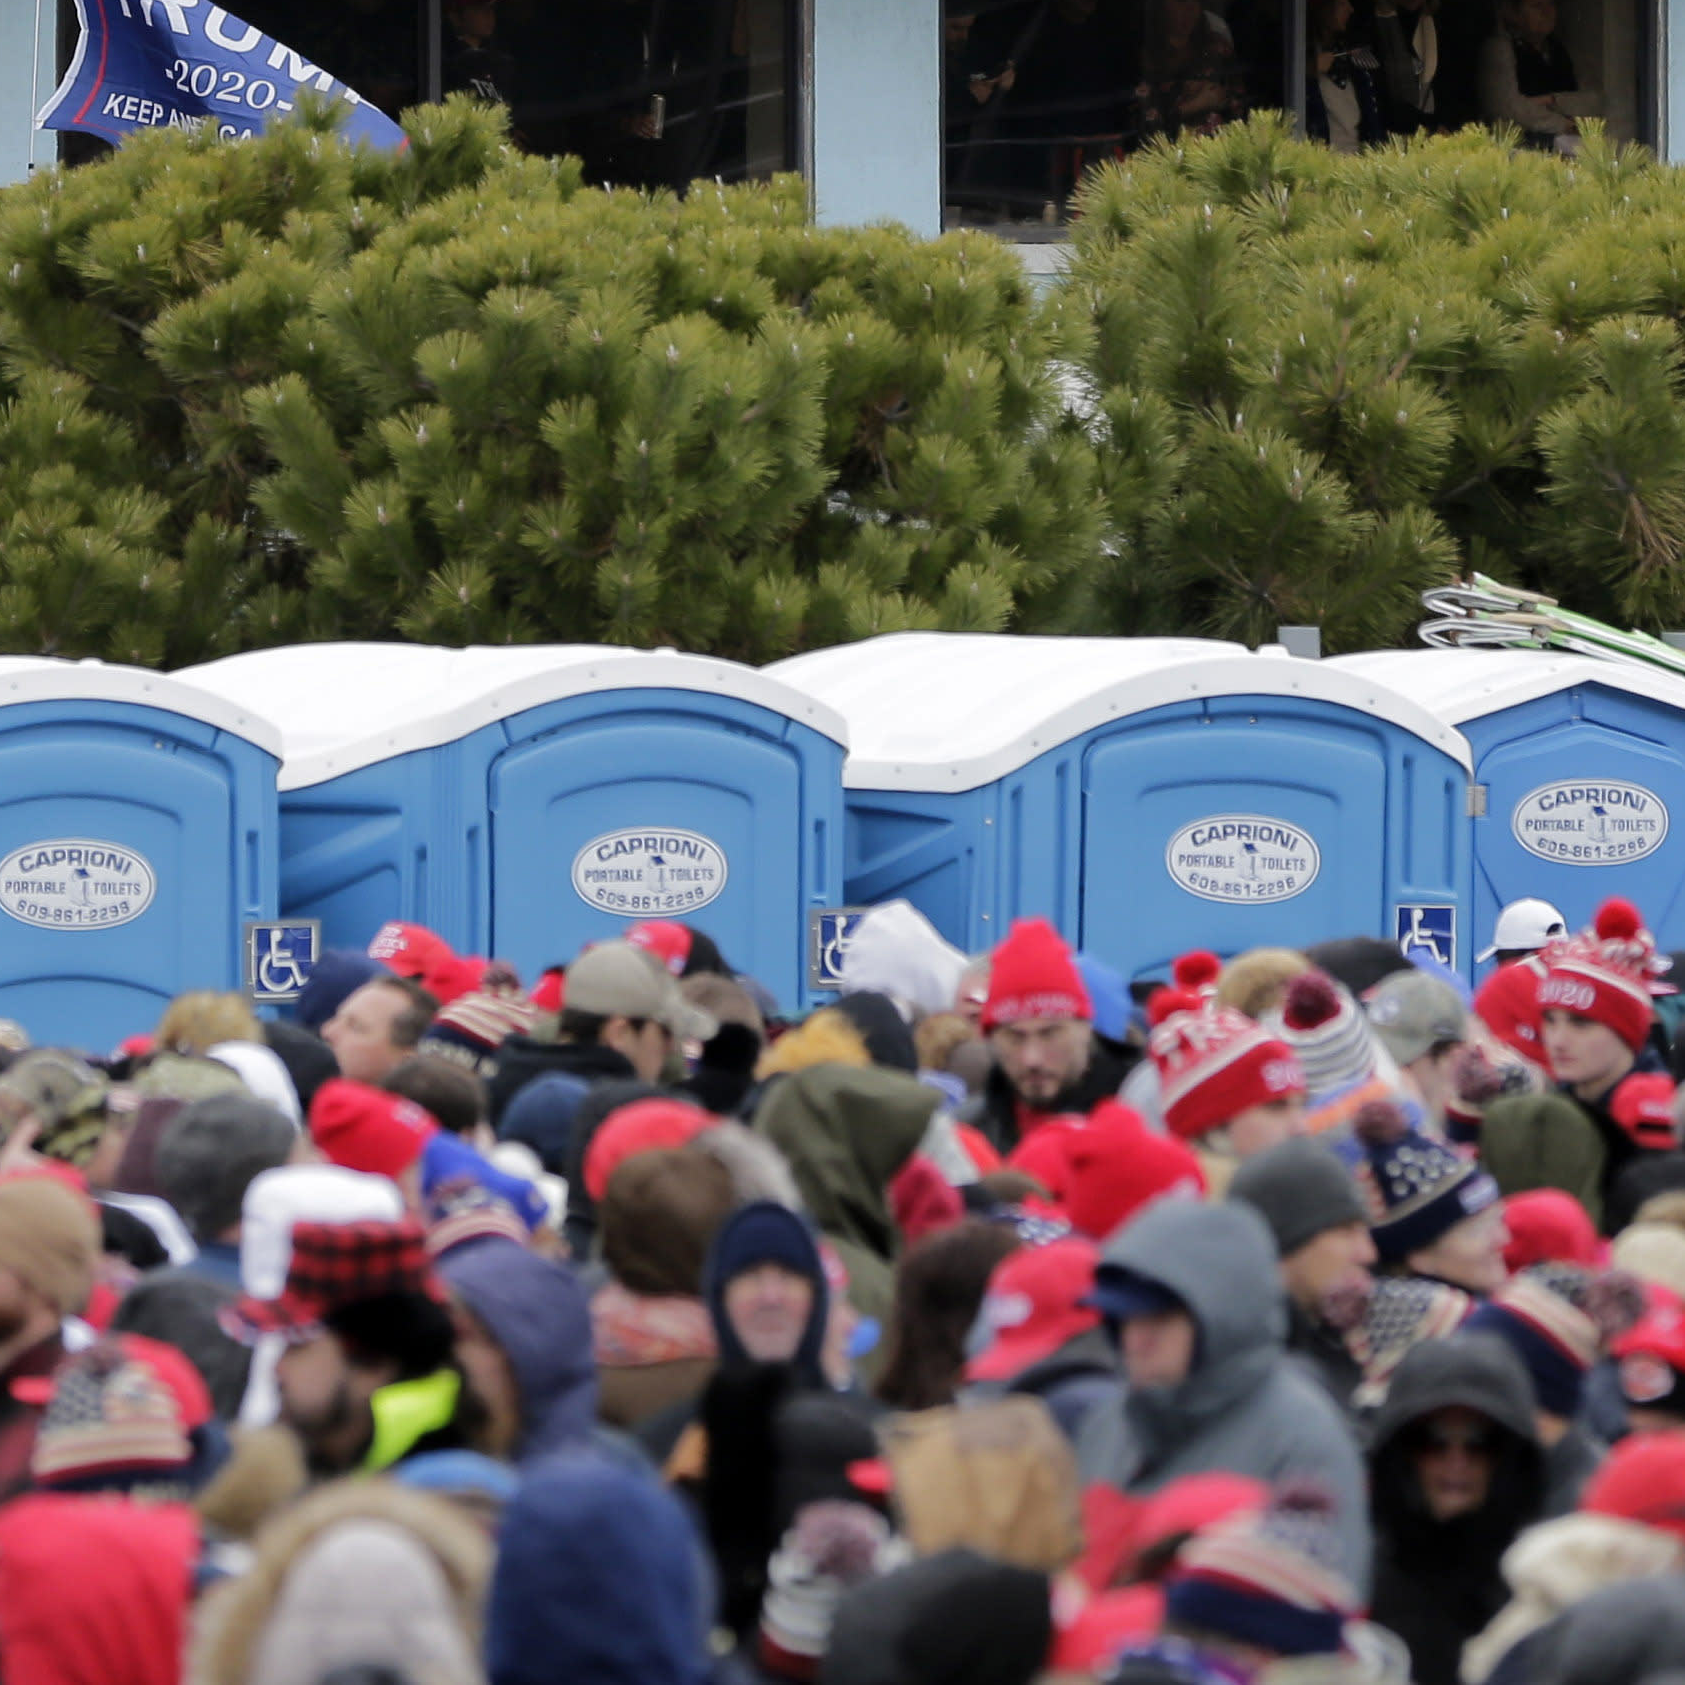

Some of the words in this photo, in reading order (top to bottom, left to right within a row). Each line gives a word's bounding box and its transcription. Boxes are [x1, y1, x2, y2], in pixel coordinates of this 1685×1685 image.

[102, 92, 163, 124] KEEP
[1538, 788, 1648, 812] CAPRIONI
[1191, 824, 1298, 851] CAPRIONI
[1525, 819, 1585, 832] PORTABLE
[1611, 819, 1656, 832] TOILETS
[596, 837, 705, 862] CAPRIONI
[18, 849, 132, 875] CAPRIONI
[1178, 854, 1235, 869] PORTABLE
[1261, 856, 1306, 871] TOILETS
[5, 881, 66, 894] PORTABLE
[94, 882, 141, 895] TOILETS
[584, 869, 643, 883] PORTABLE
[669, 869, 714, 881] TOILETS
